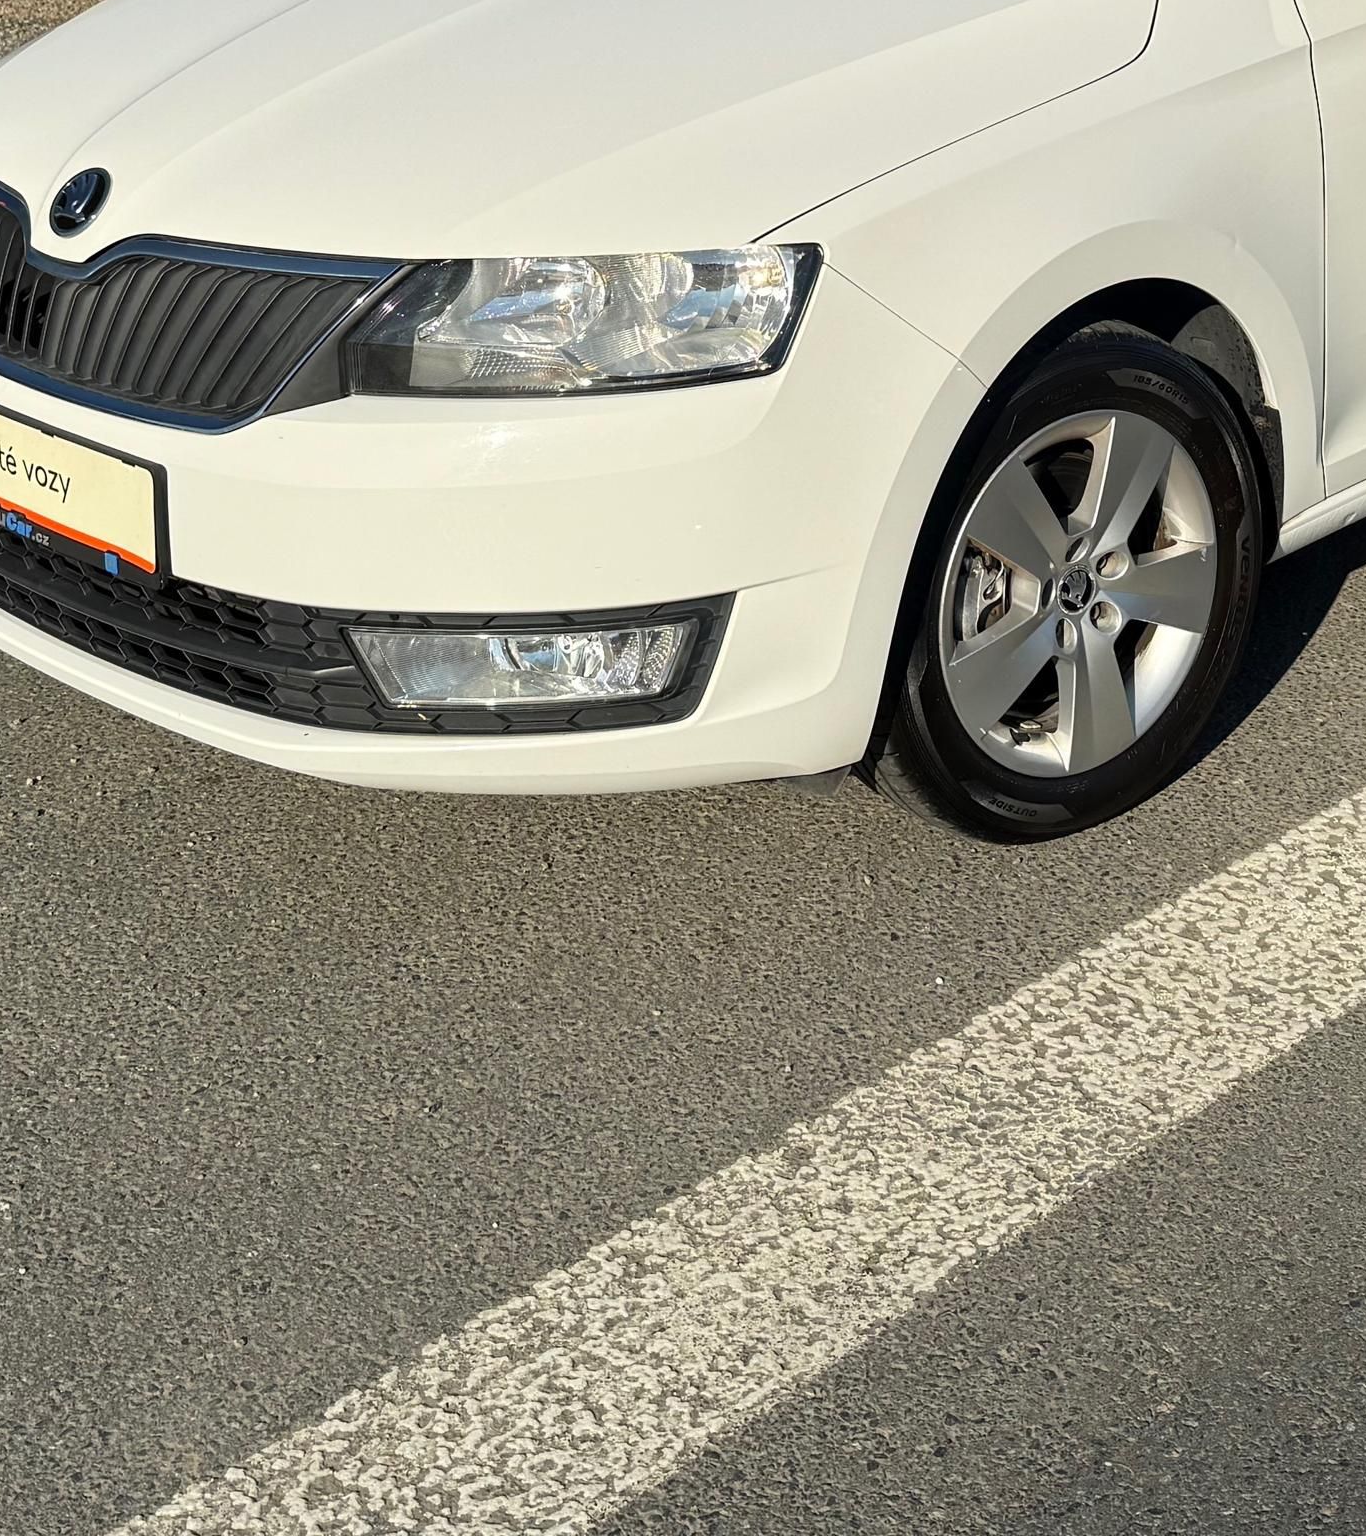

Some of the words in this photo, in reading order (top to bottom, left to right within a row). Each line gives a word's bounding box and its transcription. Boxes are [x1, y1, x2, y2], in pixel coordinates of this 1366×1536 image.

[1134, 374, 1189, 405] 185/60R15
[22, 459, 71, 503] vozy
[988, 798, 1037, 817] OUTSIDE
